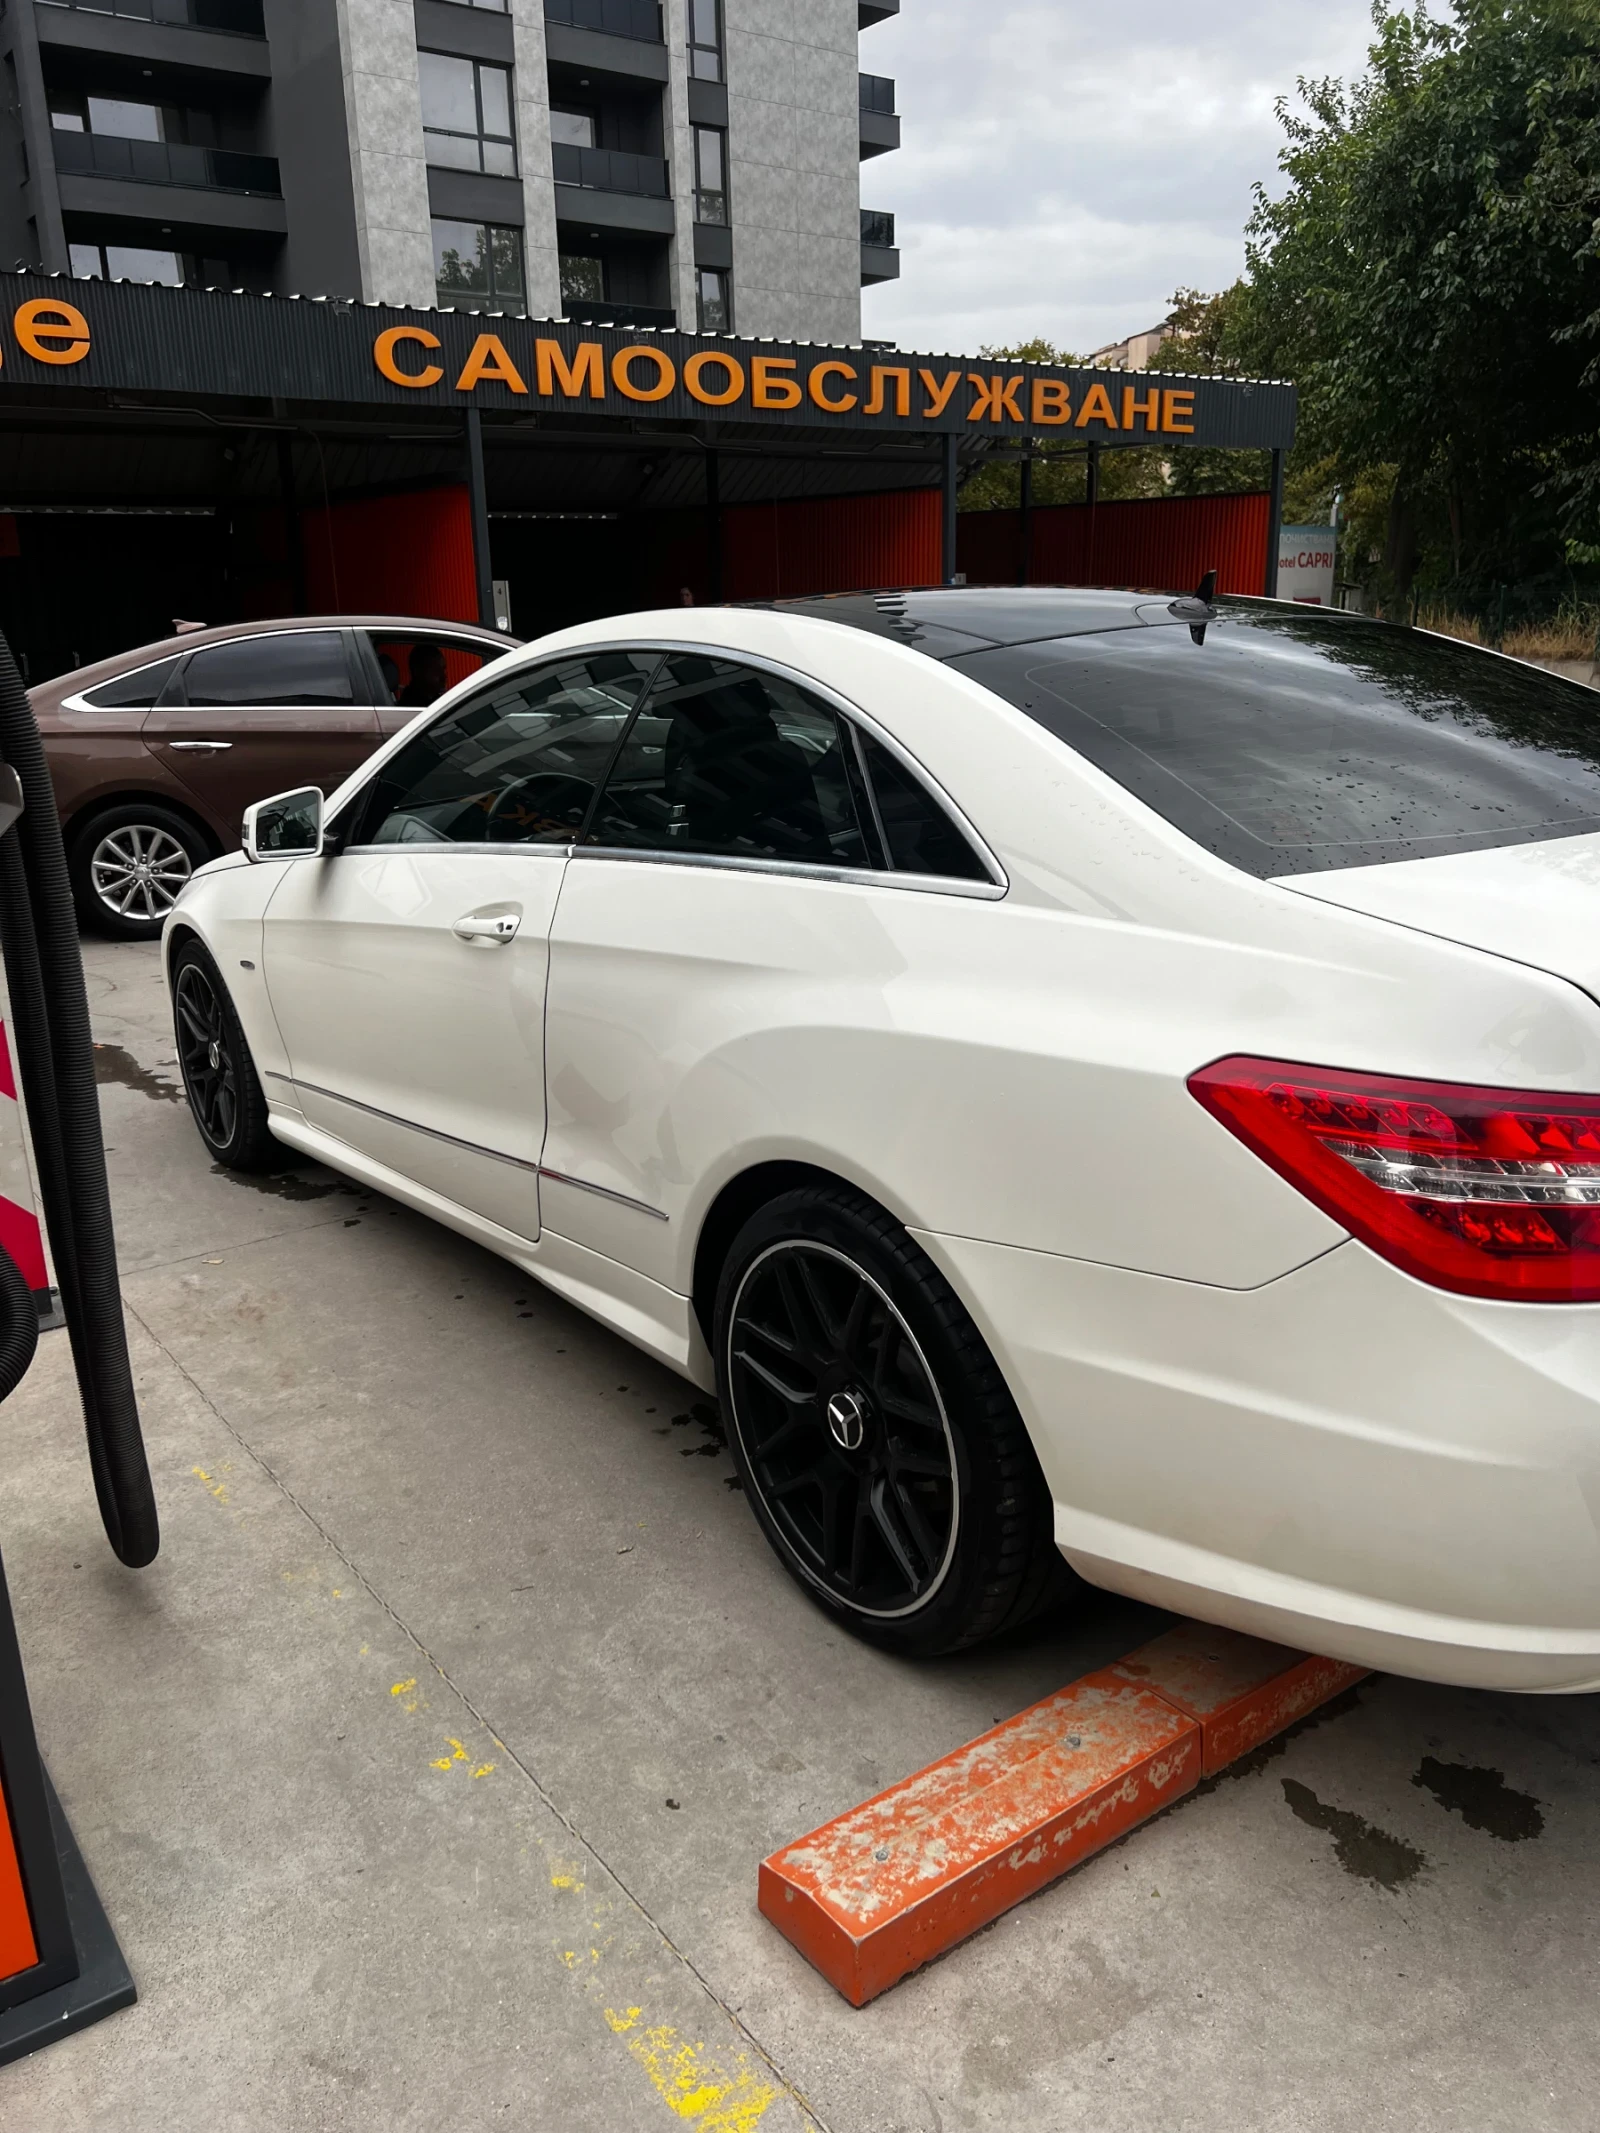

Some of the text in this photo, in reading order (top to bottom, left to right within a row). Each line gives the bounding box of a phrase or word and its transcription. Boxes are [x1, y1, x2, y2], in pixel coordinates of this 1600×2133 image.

[374, 326, 1195, 433] САМООБСЛУЖВАНЕ
[1279, 551, 1333, 569] otel CAPRI
